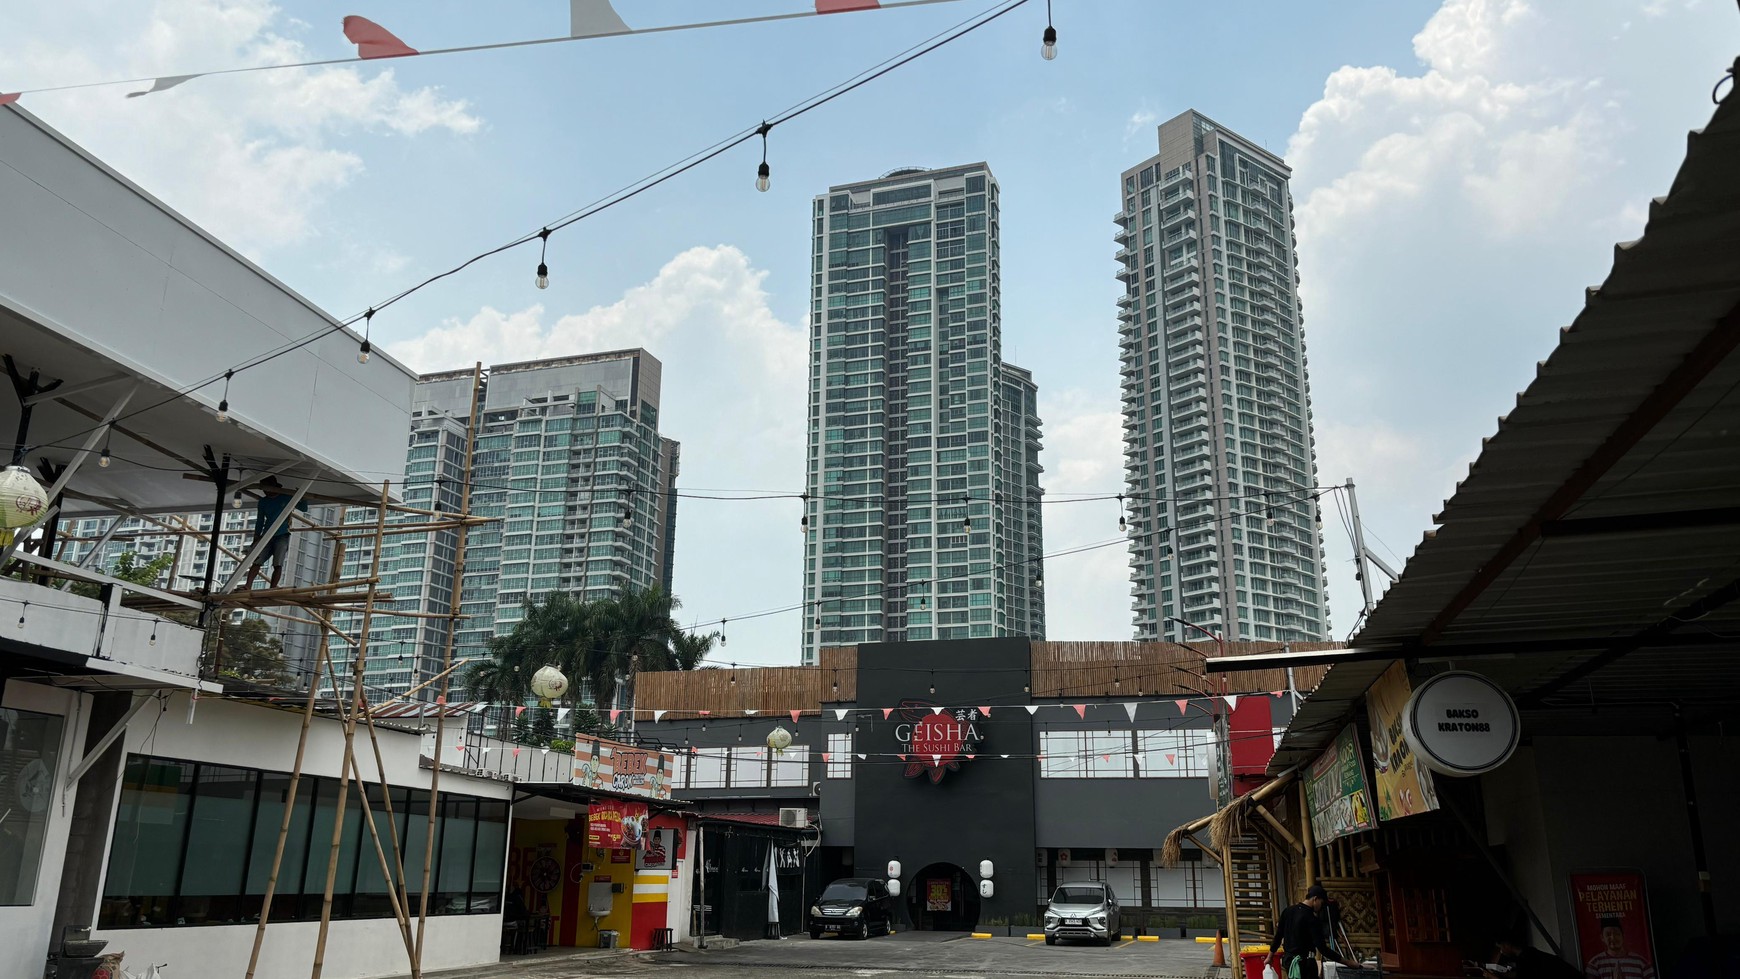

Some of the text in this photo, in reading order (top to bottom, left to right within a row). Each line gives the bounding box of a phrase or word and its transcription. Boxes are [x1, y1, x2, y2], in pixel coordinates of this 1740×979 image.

[955, 709, 978, 721] 芸者
[1446, 709, 1479, 719] BAKSO
[1438, 721, 1490, 732] KRATON88
[895, 723, 980, 742] GEISHA
[611, 748, 648, 774] BEBEK
[1610, 883, 1627, 891] MAAF
[1578, 889, 1637, 902] PELAYANAN
[1587, 901, 1633, 912] TERHENTI
